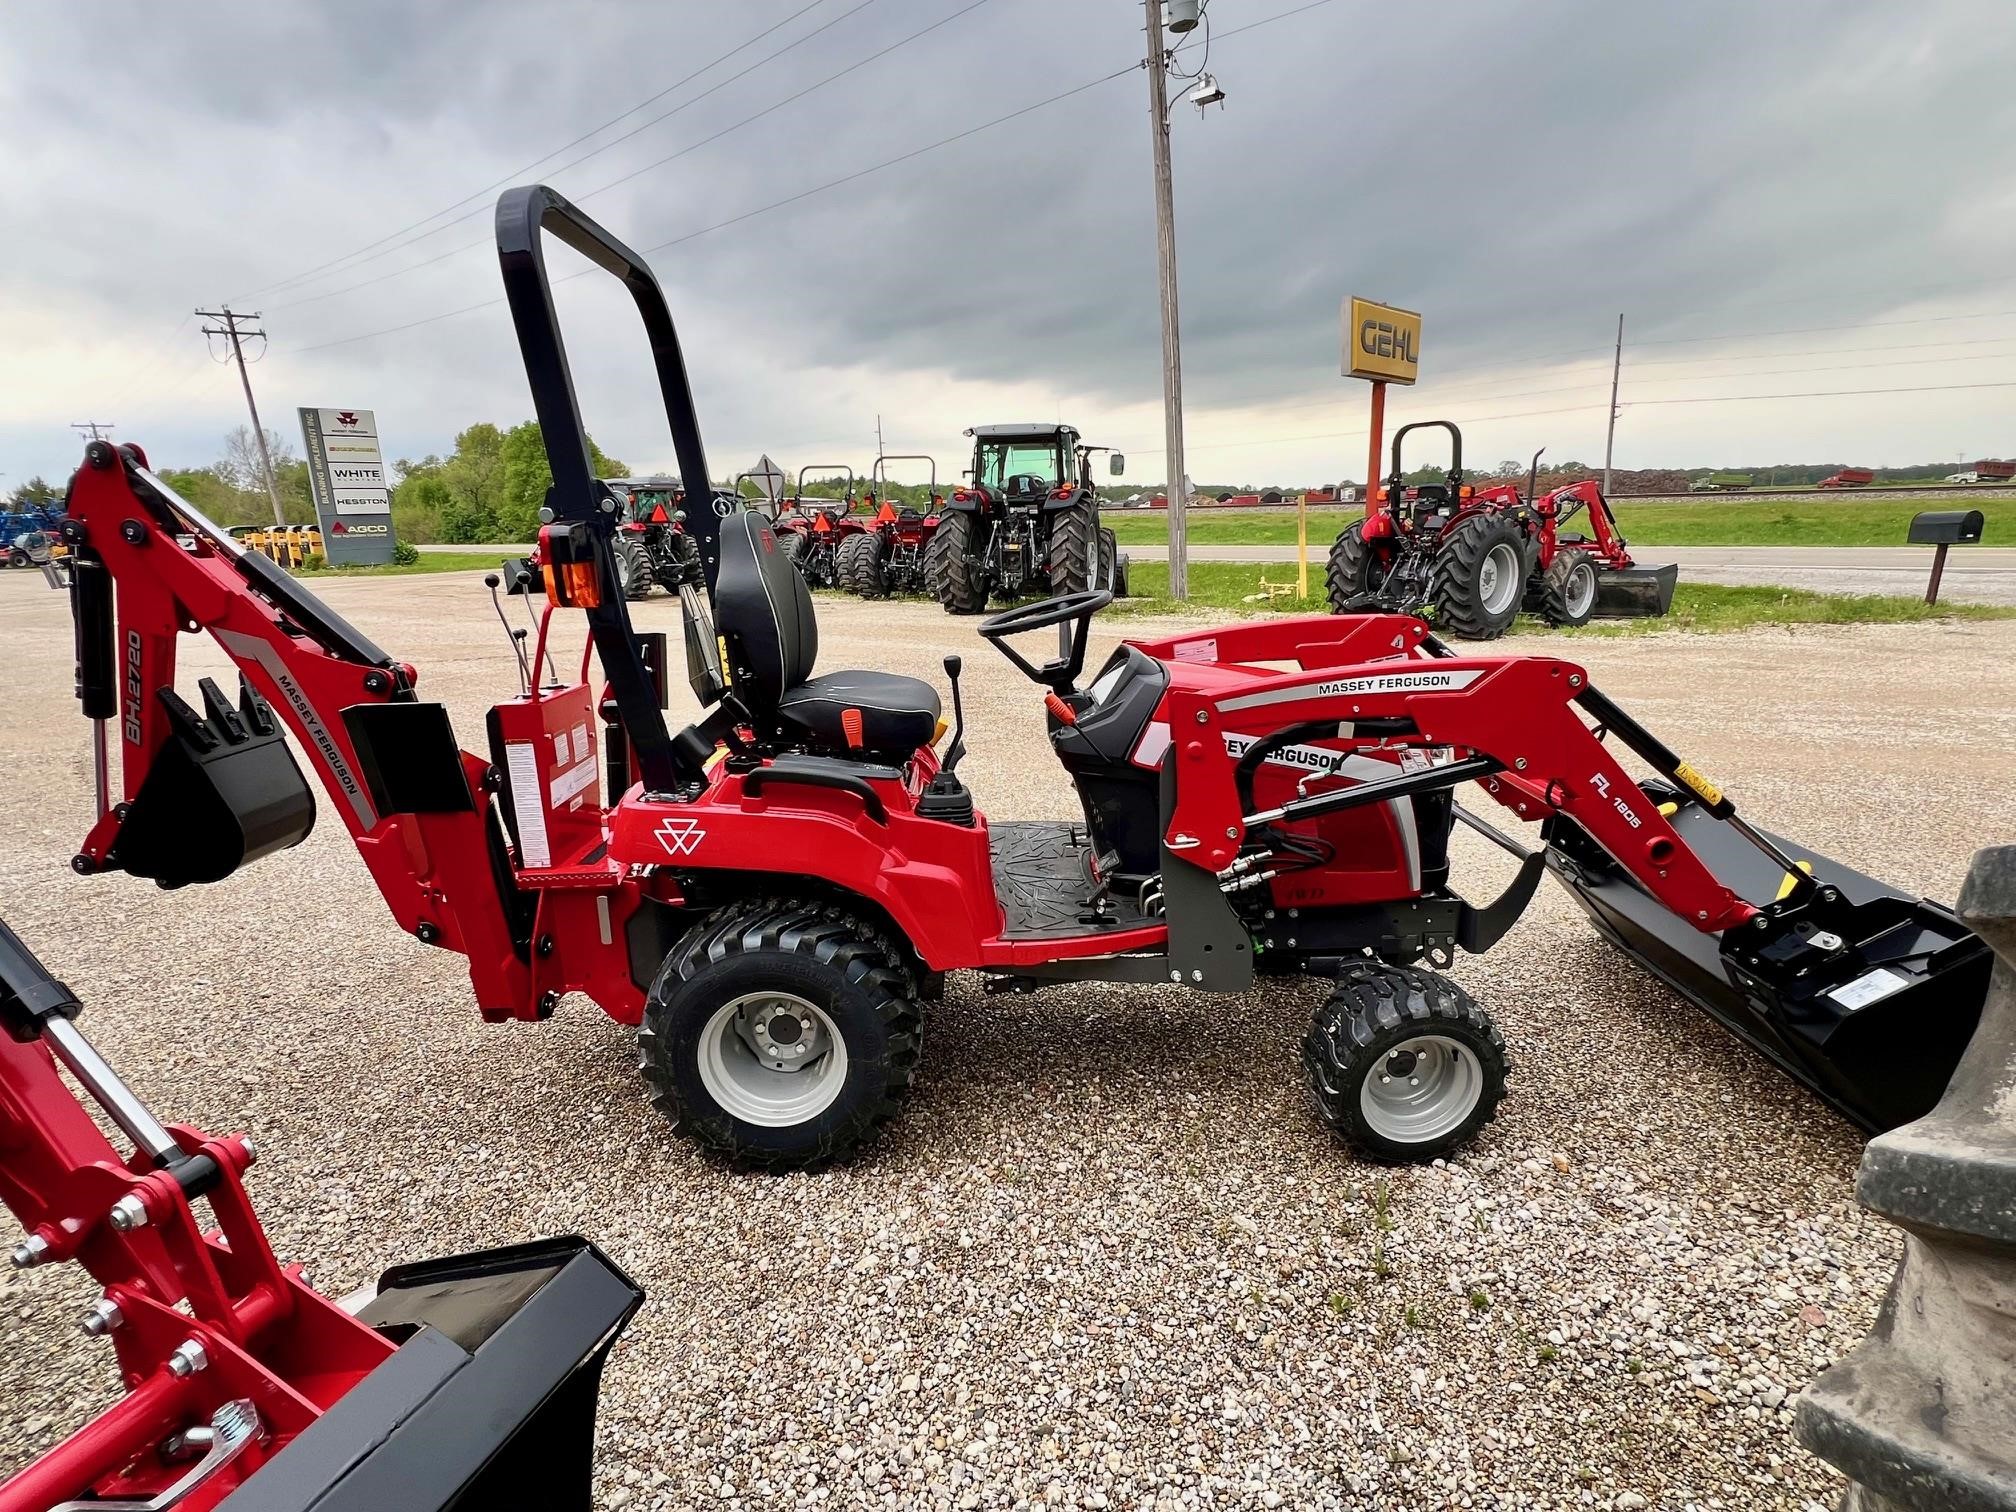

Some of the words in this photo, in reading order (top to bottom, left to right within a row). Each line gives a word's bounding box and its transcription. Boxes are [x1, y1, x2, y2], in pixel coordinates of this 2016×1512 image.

[1361, 319, 1418, 363] GEHL
[308, 428, 323, 469] IMPLEMENT
[334, 469, 381, 477] WHITE
[347, 525, 388, 533] AGCO
[126, 630, 141, 746] BH.2720
[1319, 680, 1375, 695] MASSEY
[1379, 676, 1451, 689] FERGUSON
[278, 675, 318, 726] MASSEY
[313, 728, 358, 795] FERGUSON
[1223, 739, 1250, 754] EY
[1588, 772, 1611, 799] FL
[1613, 797, 1643, 829] 1805
